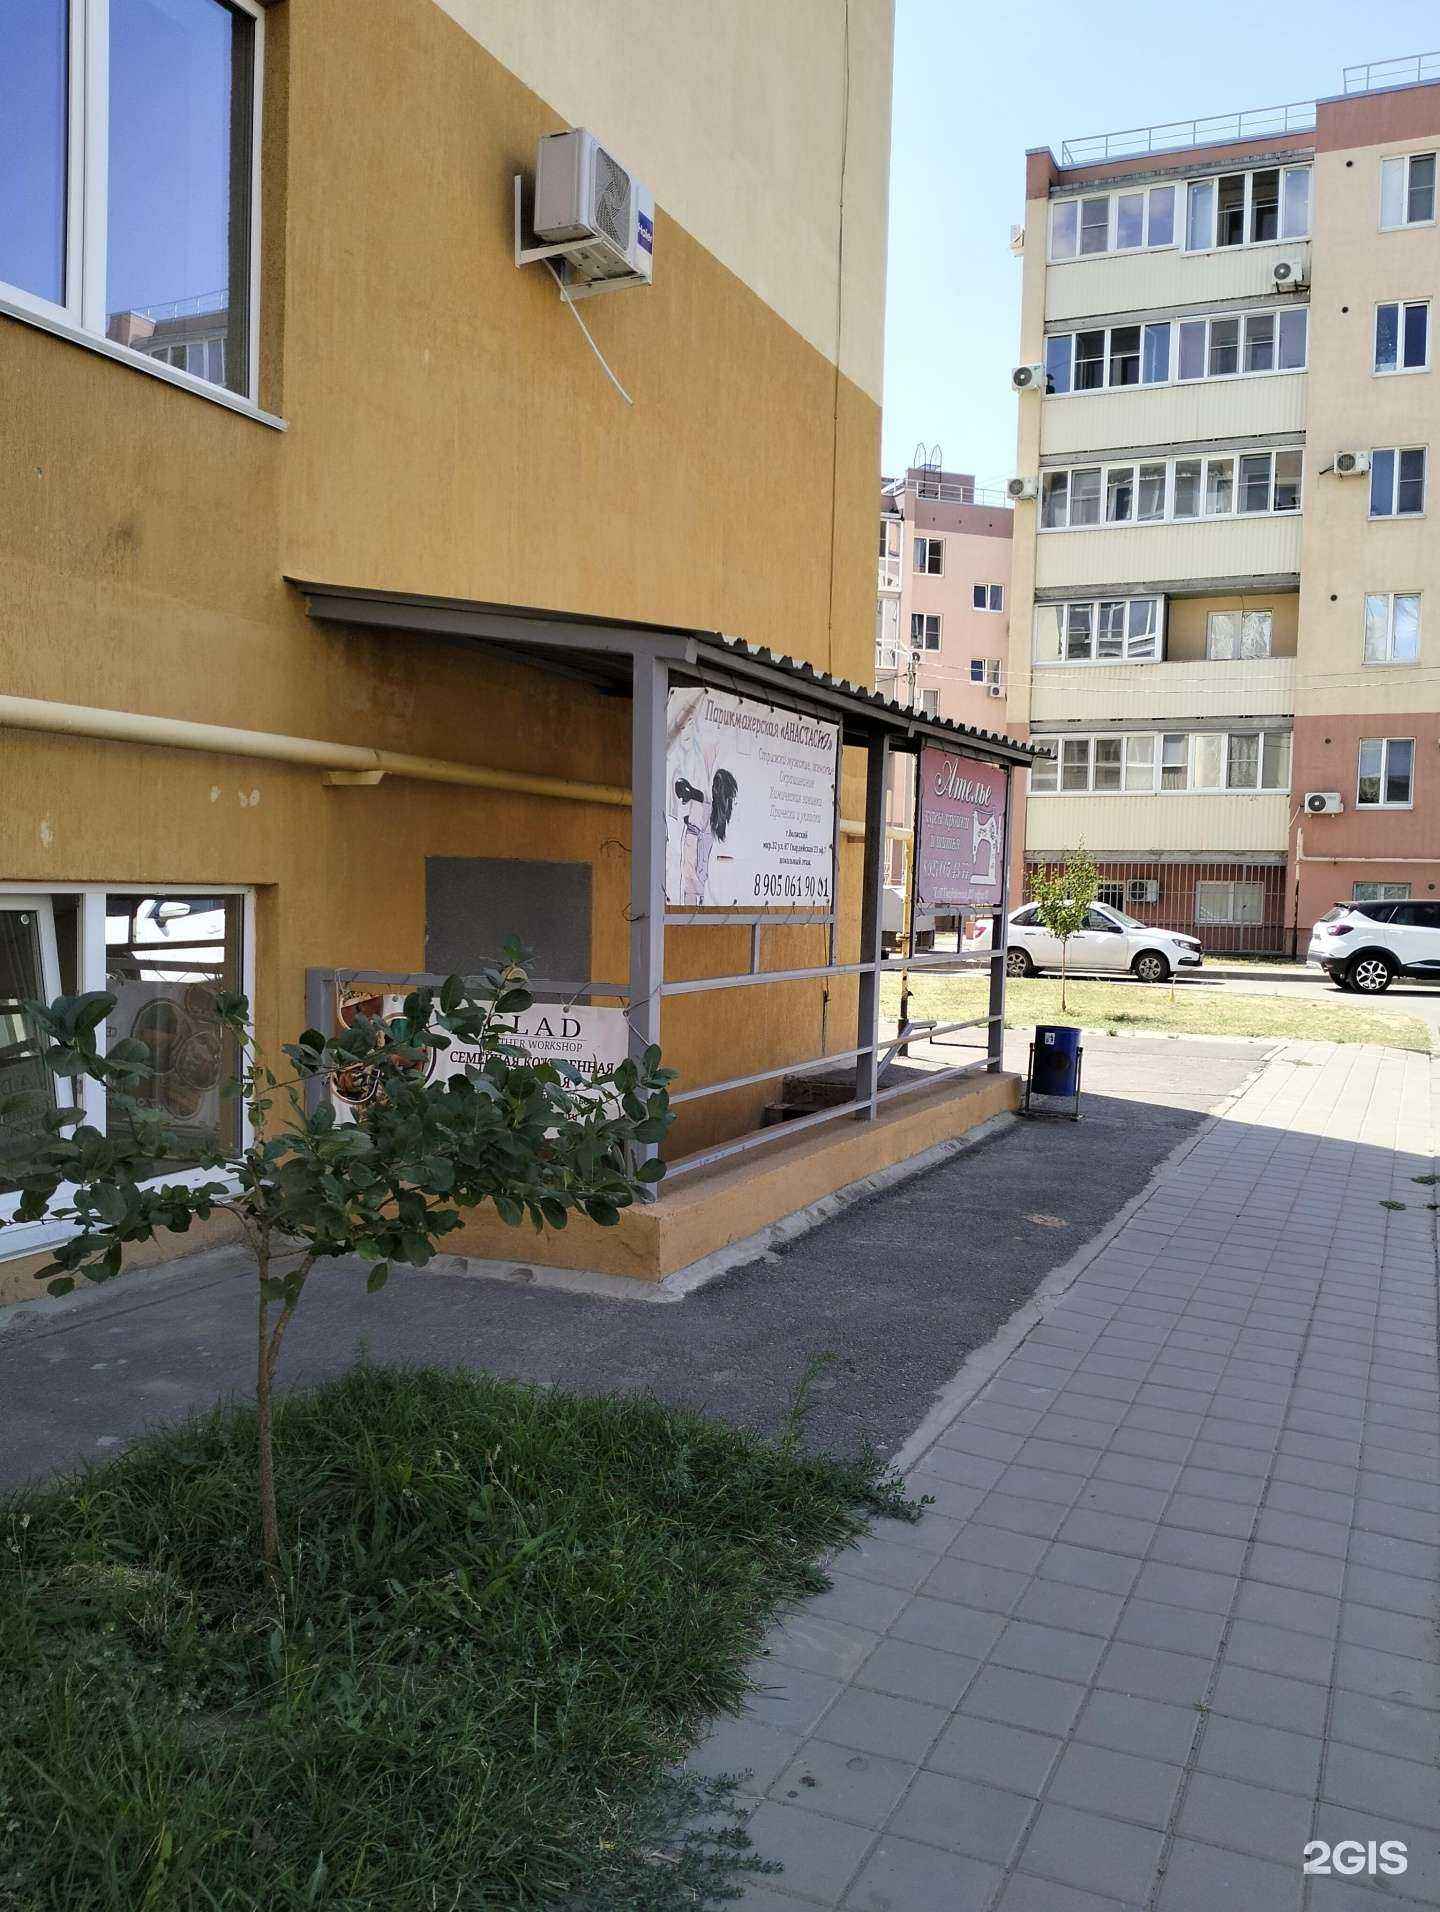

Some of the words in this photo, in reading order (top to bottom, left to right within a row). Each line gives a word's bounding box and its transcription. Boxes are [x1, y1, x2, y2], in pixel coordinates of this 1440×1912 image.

[704, 700, 779, 738] Парикмахерская
[934, 758, 993, 807] Ателье
[753, 873, 761, 896] 8
[763, 873, 782, 897] 905
[784, 875, 802, 897] 061
[529, 1040, 583, 1052] WORKSHOP
[450, 1051, 519, 1067] СЕМЕАЯ
